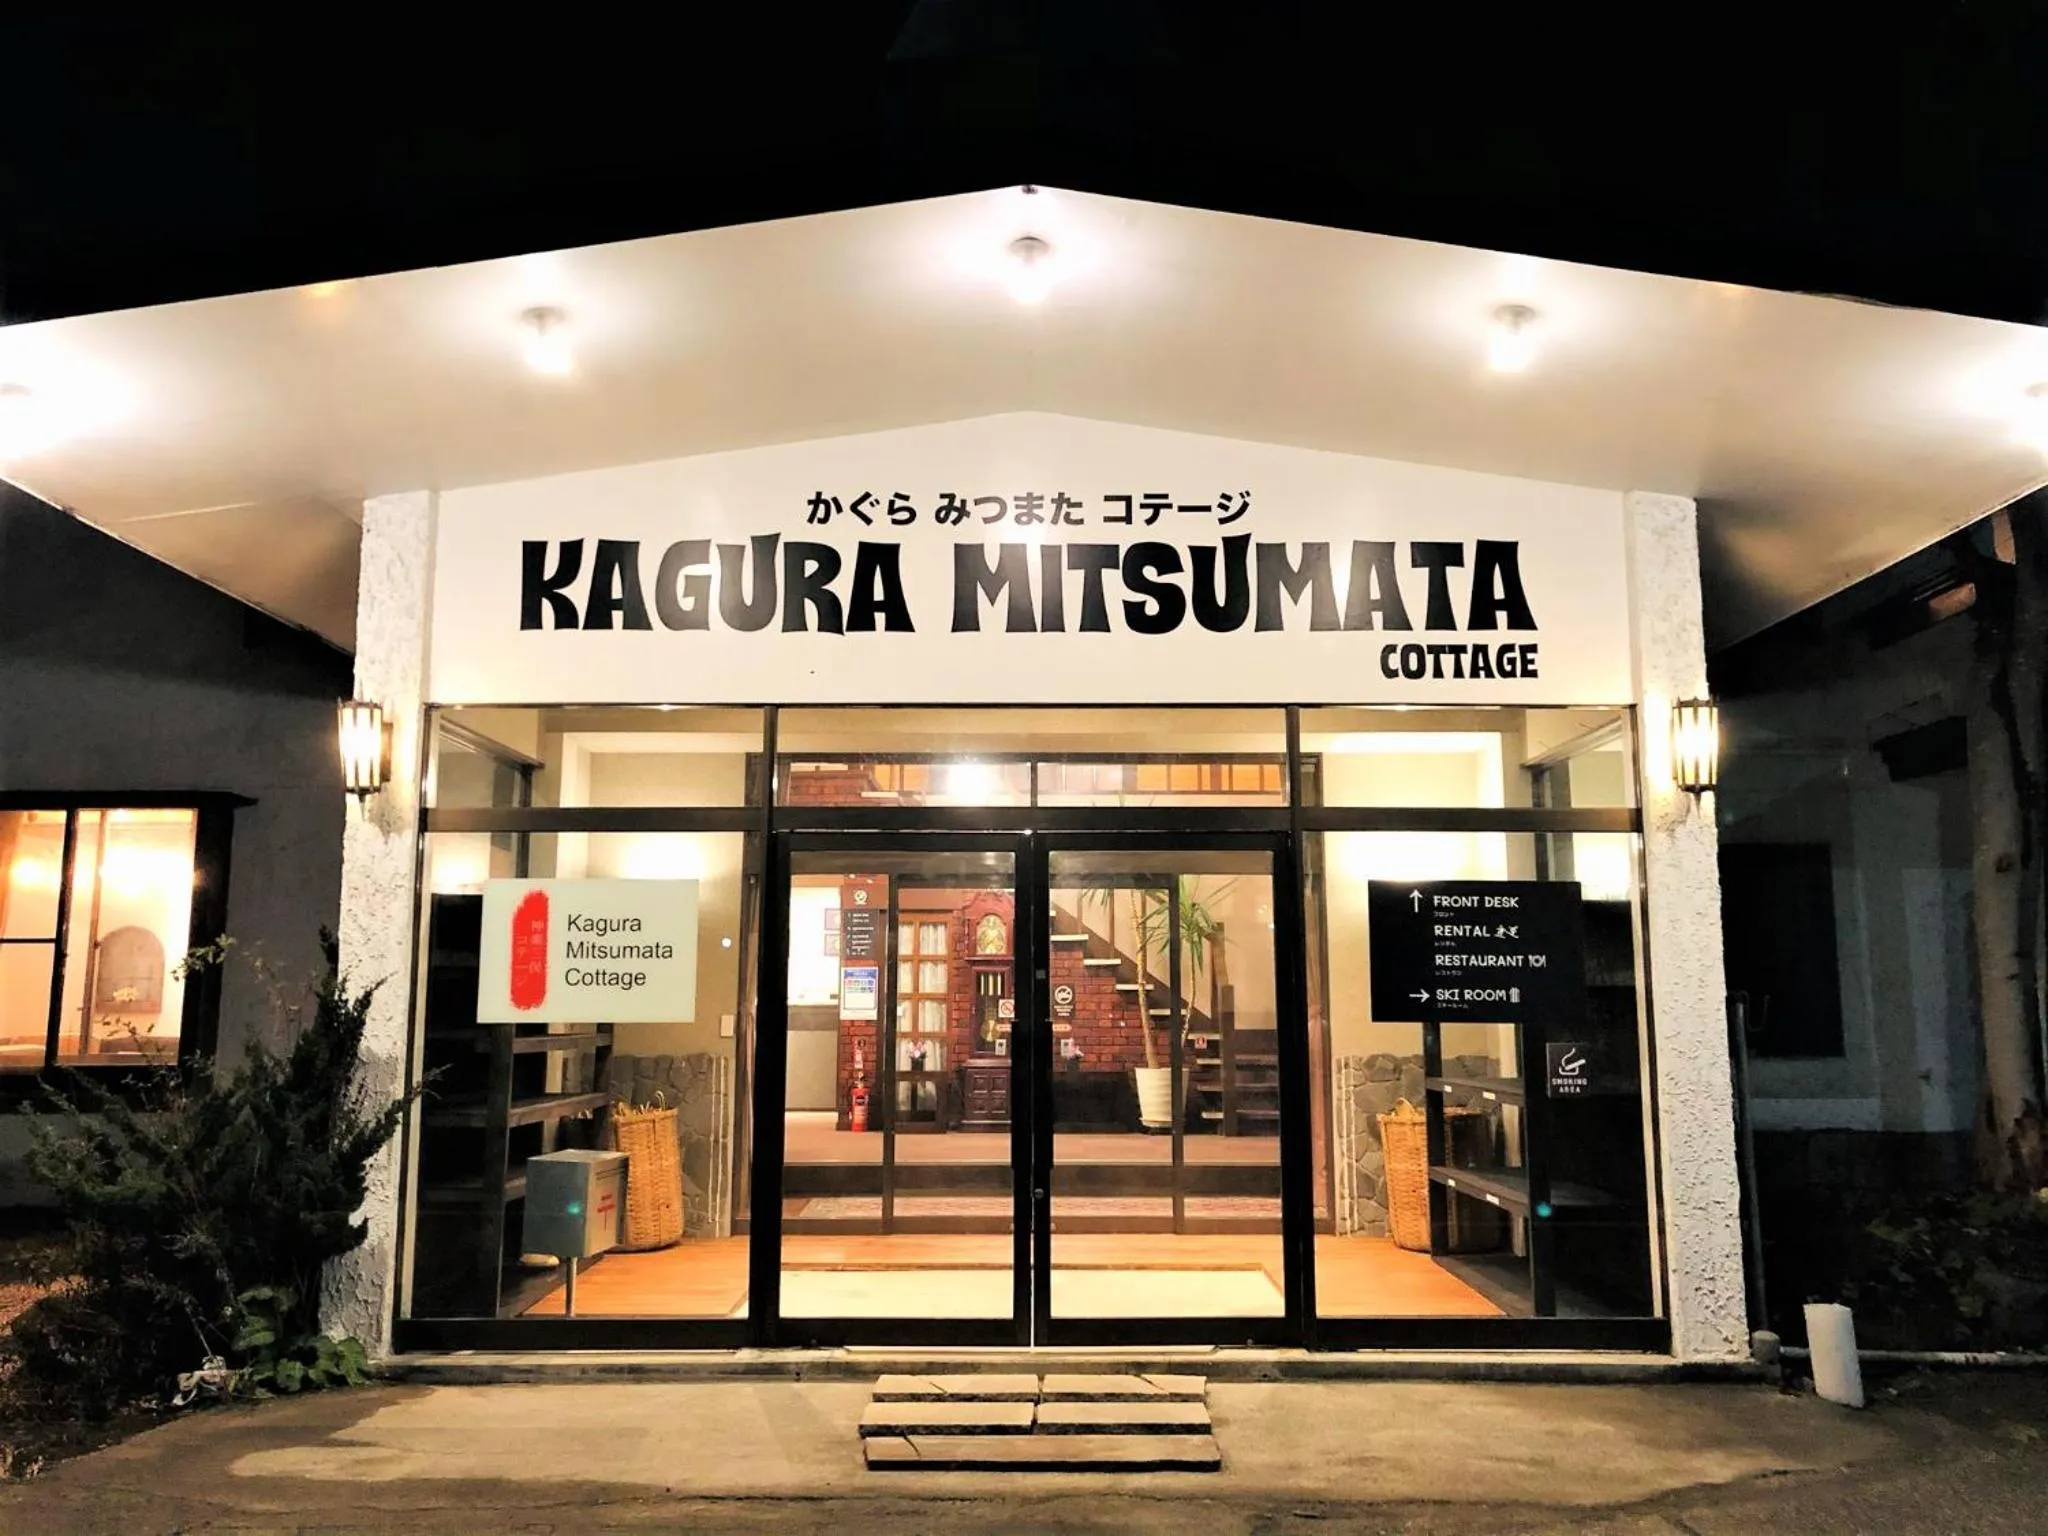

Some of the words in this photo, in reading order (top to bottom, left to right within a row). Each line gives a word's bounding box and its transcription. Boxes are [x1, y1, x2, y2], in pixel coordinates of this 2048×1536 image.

[806, 490, 918, 527] かぐら
[934, 491, 1085, 527] みつまた
[1102, 489, 1252, 527] コテージ
[519, 532, 916, 636] KAGURA
[950, 532, 1539, 635] MITSUMATA
[1380, 642, 1539, 680] COTTAGE
[1433, 894, 1480, 908] FRONT
[1484, 895, 1519, 908] DESK
[567, 913, 642, 937] Kagura
[1434, 924, 1491, 938] RENTAL
[565, 940, 673, 960] Mitsumata
[1434, 954, 1524, 967] RESTAURANT
[564, 967, 647, 990] Cottage
[1435, 988, 1460, 1001] SKI
[1463, 989, 1507, 1001] ROOM
[1551, 1077, 1588, 1085] SMOKING
